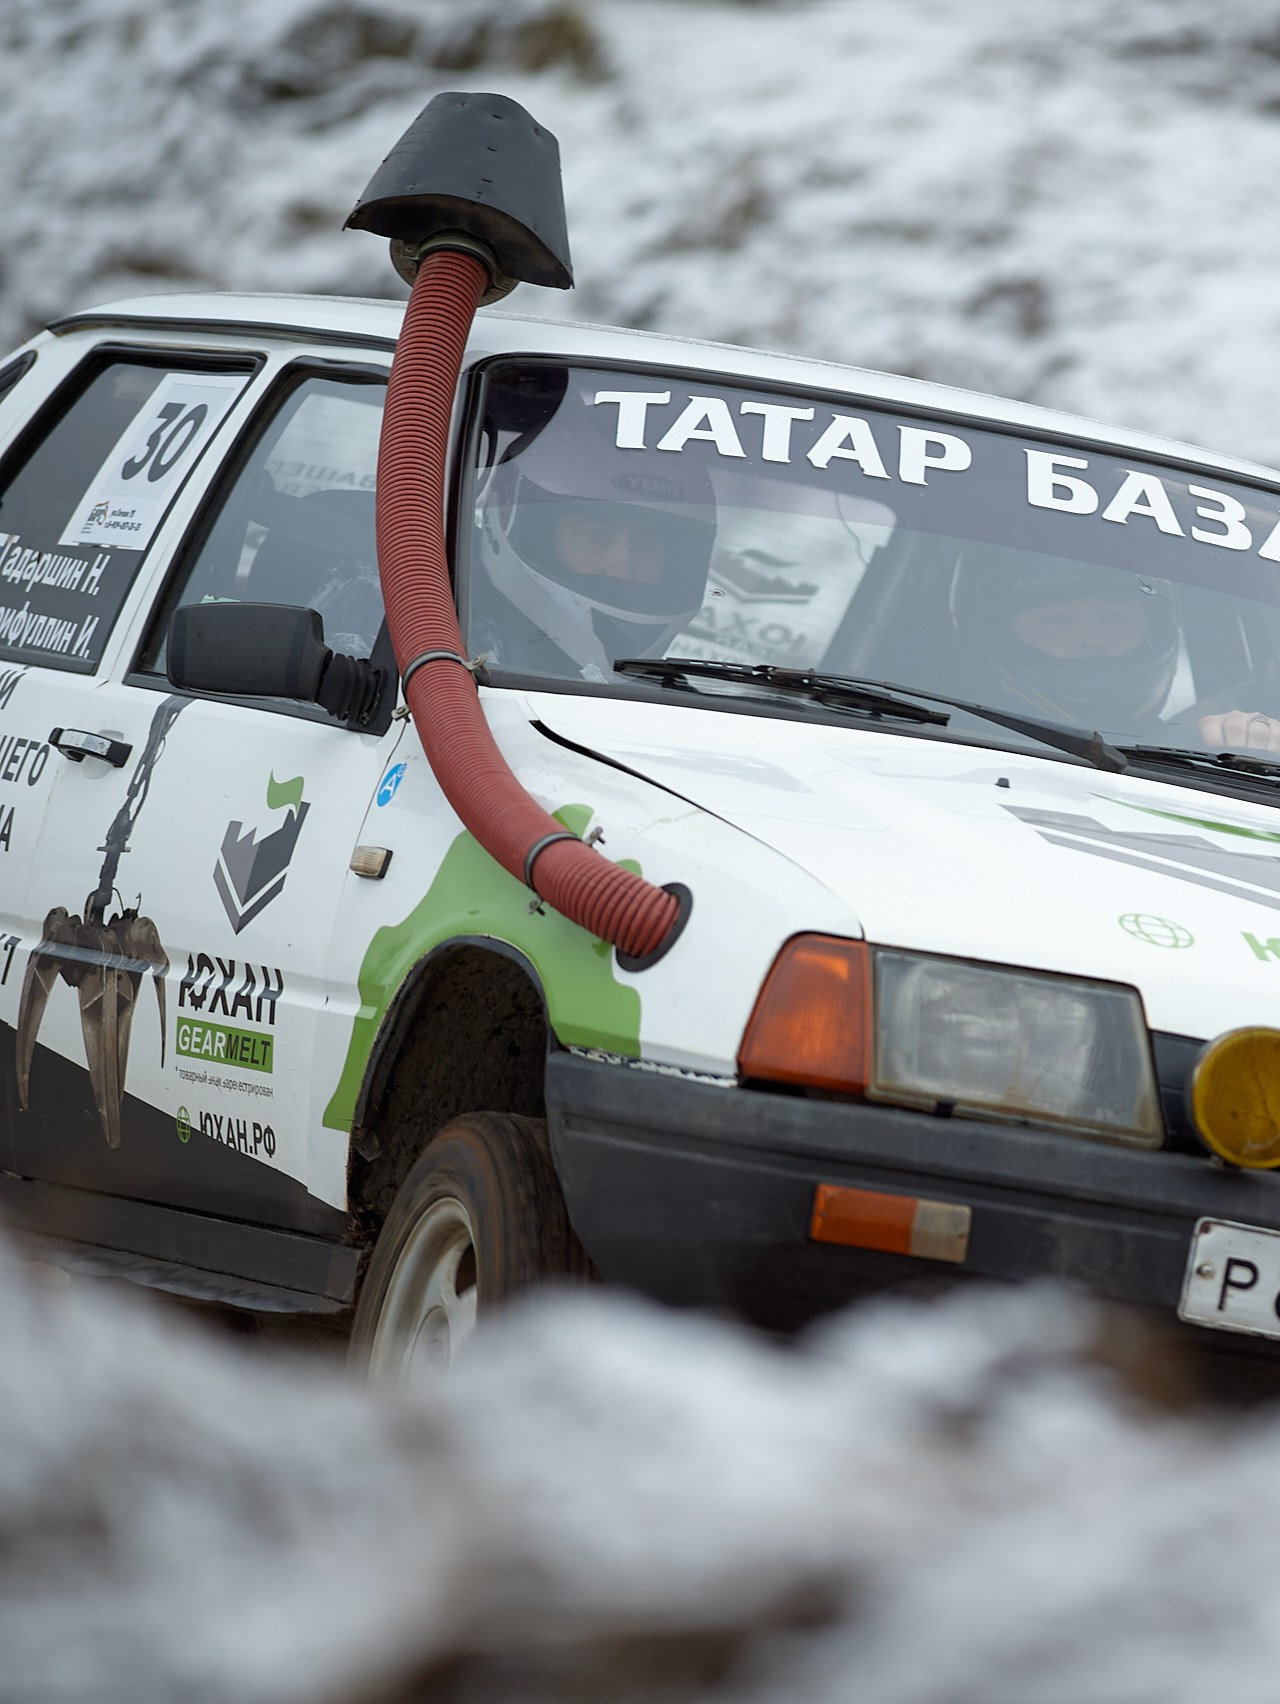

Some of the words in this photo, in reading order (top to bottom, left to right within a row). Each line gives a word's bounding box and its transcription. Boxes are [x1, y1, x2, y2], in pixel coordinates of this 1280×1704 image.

[121, 402, 208, 482] 30
[594, 391, 973, 486] ТАТАР
[81, 553, 111, 595] Н.
[71, 614, 100, 659] И.
[178, 953, 284, 1025] ЮХАН
[179, 1024, 271, 1066] GEARMELT
[199, 1110, 276, 1158] ЮХАН.РФ
